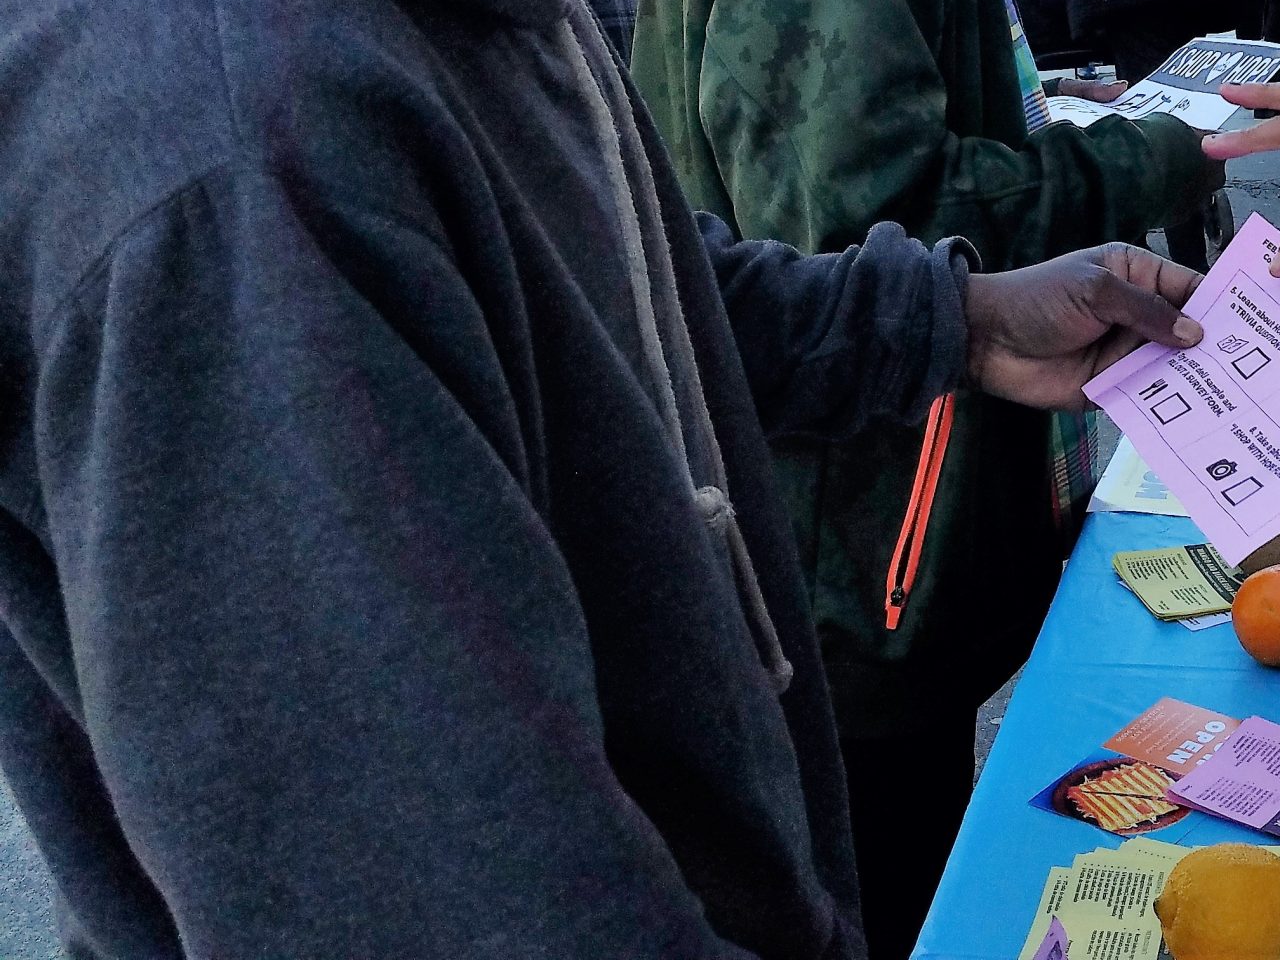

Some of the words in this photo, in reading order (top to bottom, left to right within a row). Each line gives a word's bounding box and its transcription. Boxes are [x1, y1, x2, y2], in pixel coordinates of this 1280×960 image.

[1172, 49, 1222, 79] SHOP
[1262, 238, 1280, 254] FEB.
[1230, 286, 1237, 294] 5.
[1237, 291, 1257, 312] Learn
[1256, 309, 1275, 328] about
[1232, 305, 1257, 328] TRIVIA
[1194, 365, 1210, 380] deli
[1184, 372, 1209, 400] SURVEY
[1204, 394, 1224, 417] FORM.
[1201, 375, 1228, 401] sample
[1221, 396, 1238, 413] and
[1232, 426, 1251, 444] SHOP
[1247, 442, 1265, 460] WITH
[1252, 431, 1269, 447] Take
[1161, 718, 1235, 765] OPEN
